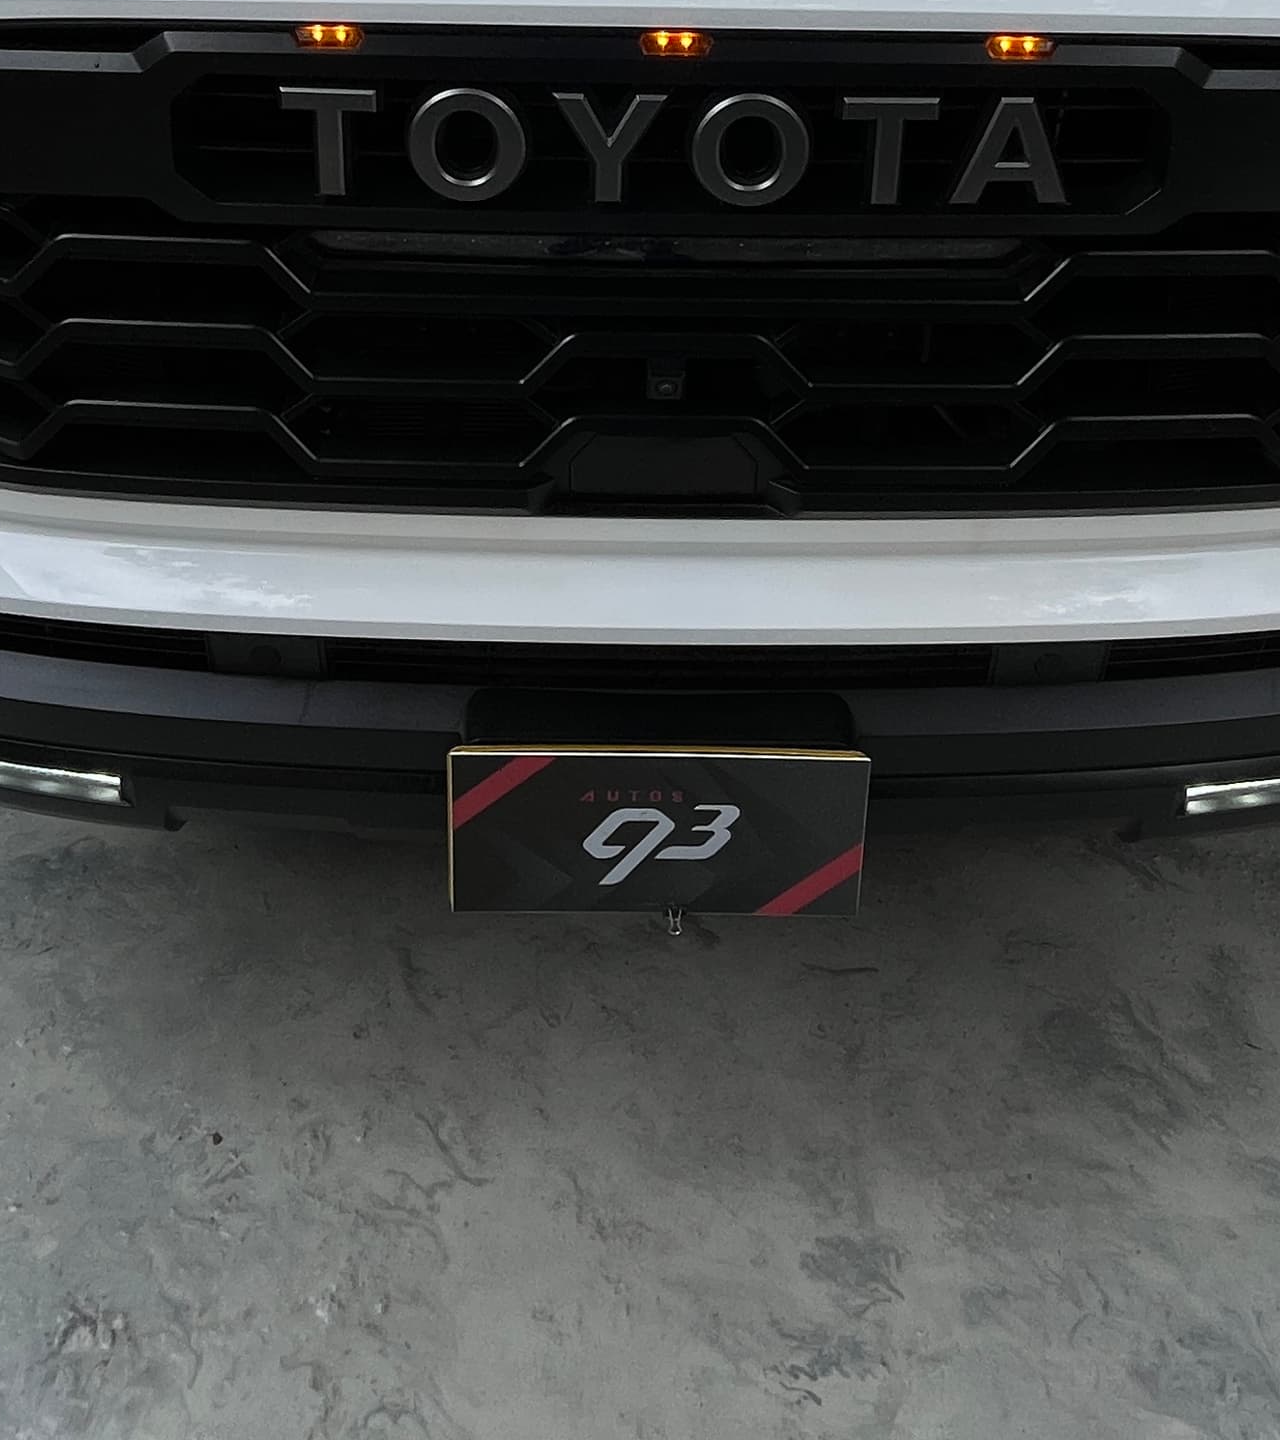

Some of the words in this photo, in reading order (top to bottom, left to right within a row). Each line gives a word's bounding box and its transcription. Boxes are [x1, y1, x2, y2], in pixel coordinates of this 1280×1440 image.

[279, 86, 1068, 206] TOYOTA
[580, 789, 685, 803] AUTOS
[582, 804, 741, 886] 93
